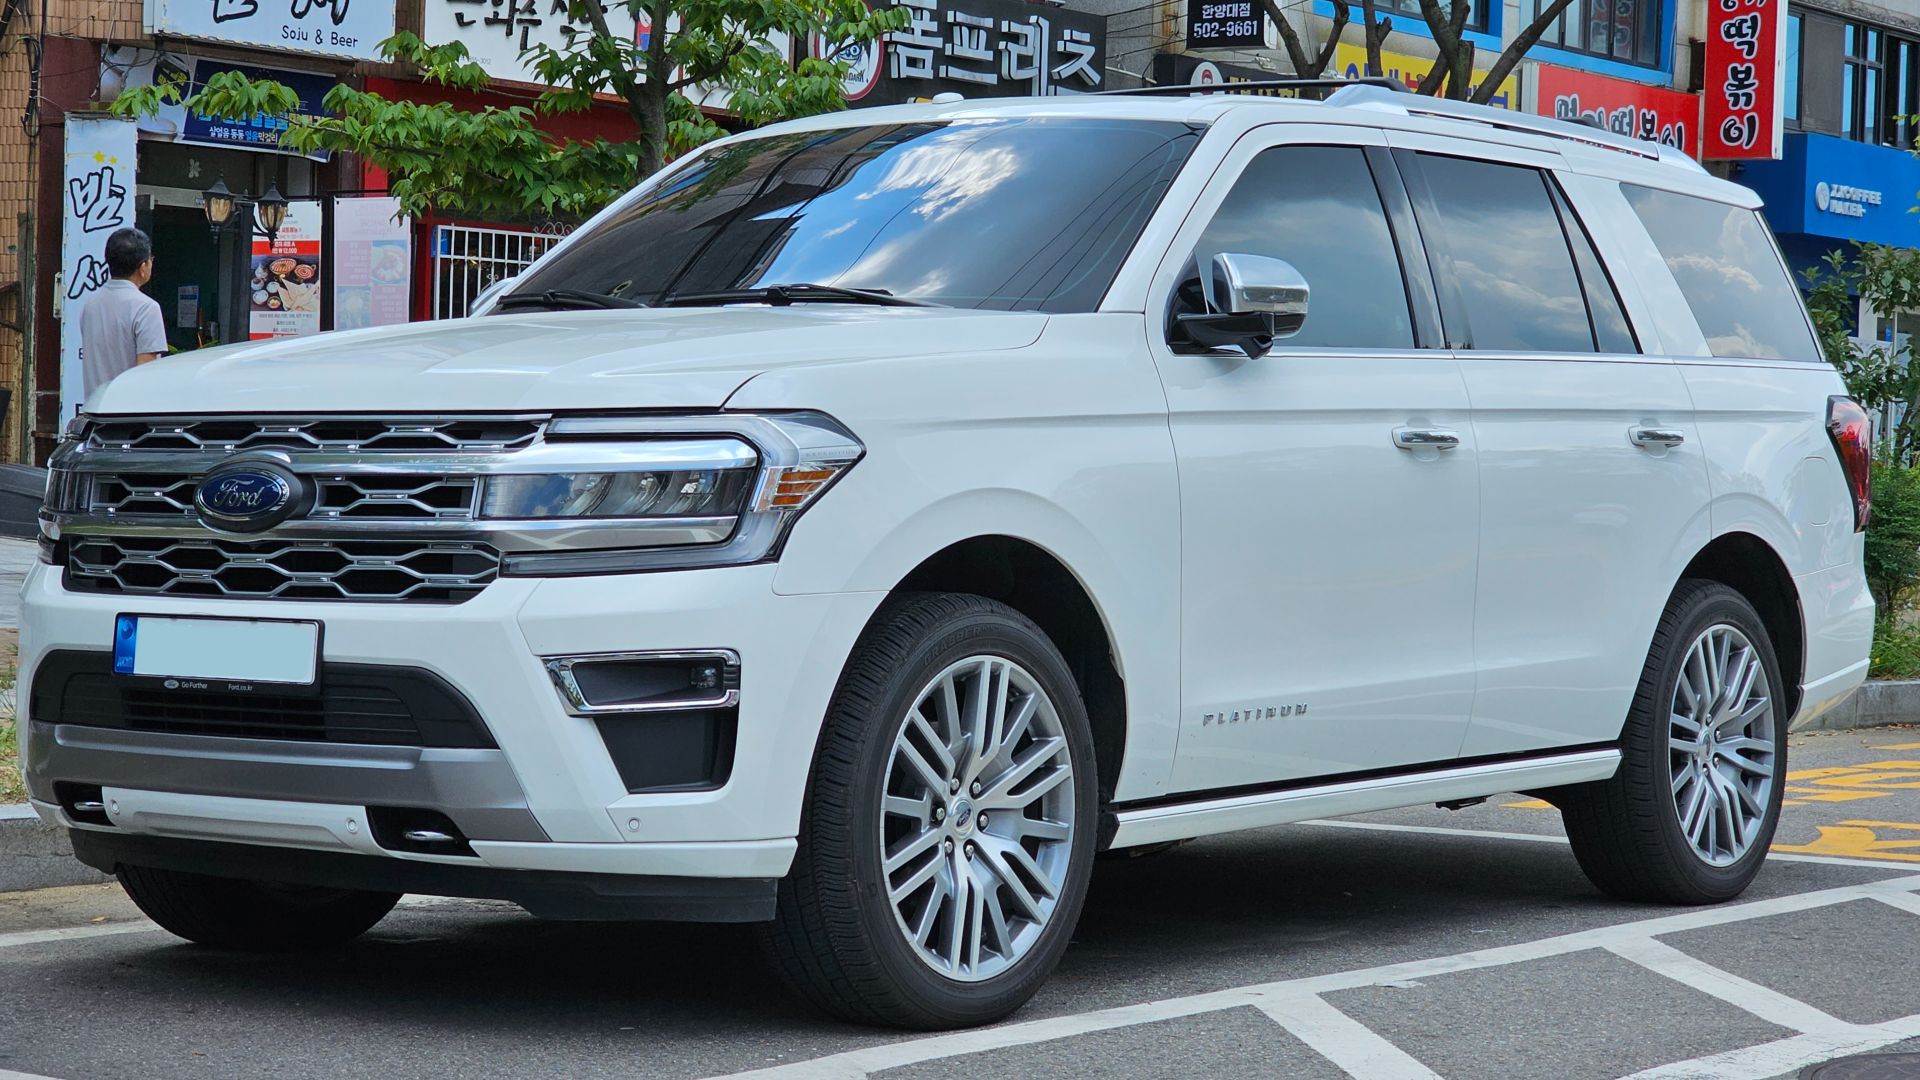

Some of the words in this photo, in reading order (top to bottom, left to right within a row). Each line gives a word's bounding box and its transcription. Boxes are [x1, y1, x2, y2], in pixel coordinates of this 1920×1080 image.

[1202, 3, 1251, 19] 한양대점
[282, 25, 308, 41] Soju
[315, 30, 324, 44] &
[330, 33, 358, 48] Beer
[1194, 20, 1258, 38] 502-9661
[1720, 0, 1761, 149] 떡볶이
[214, 479, 262, 507] Ford
[189, 682, 208, 690] Further
[1203, 702, 1307, 727] PLATINUM
